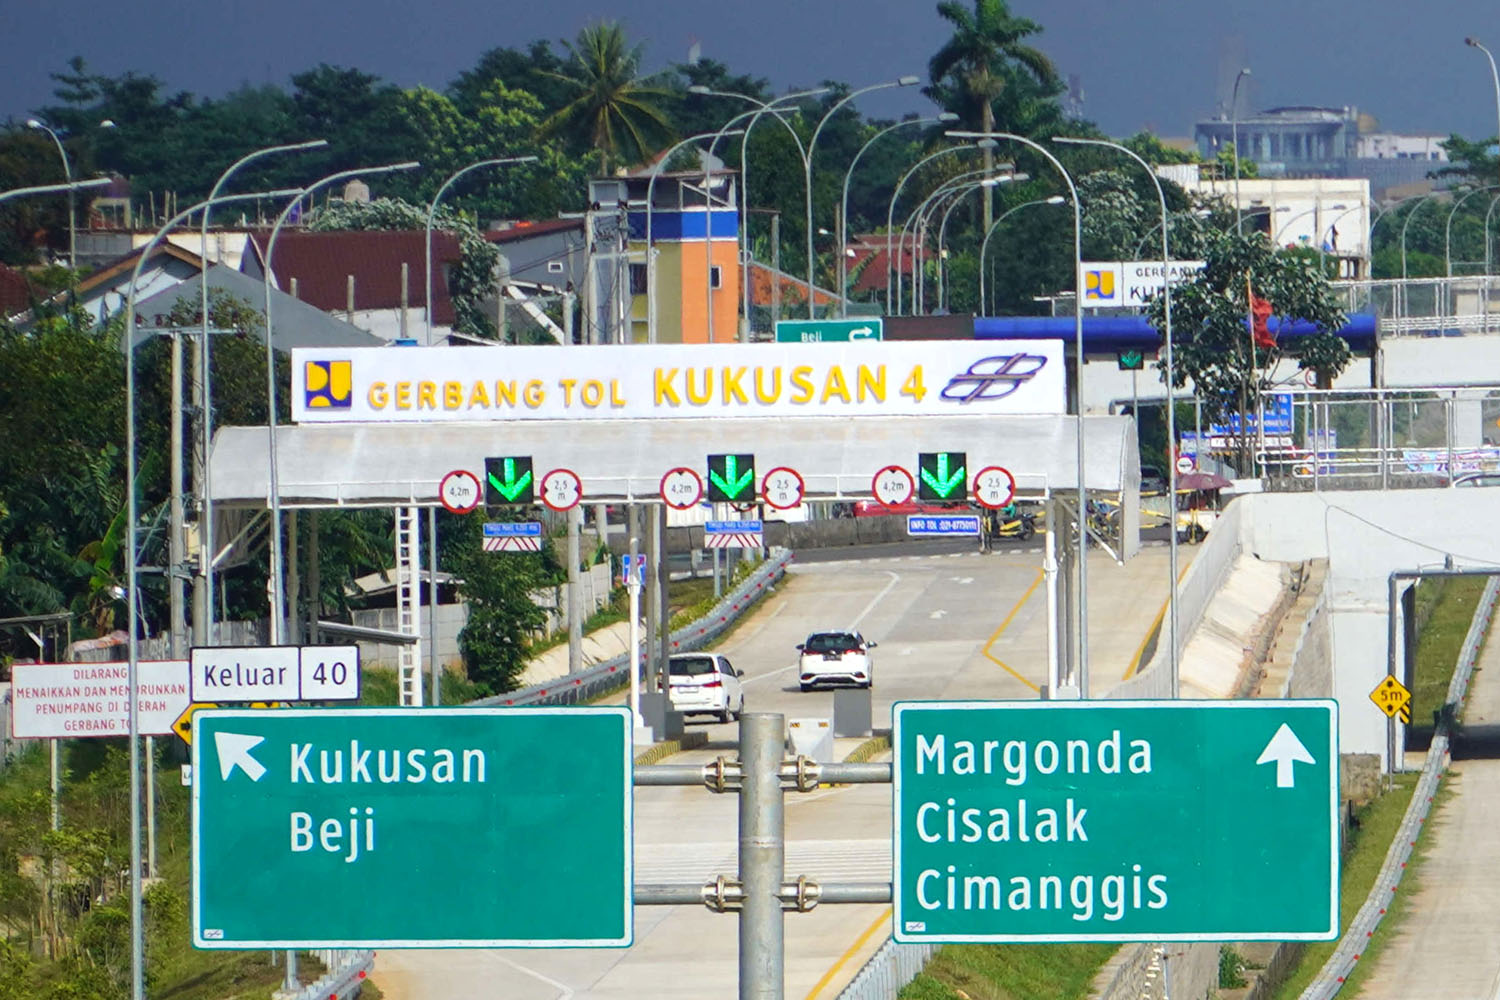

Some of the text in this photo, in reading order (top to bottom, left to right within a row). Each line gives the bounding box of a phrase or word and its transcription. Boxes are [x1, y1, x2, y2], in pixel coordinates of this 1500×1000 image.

[368, 364, 928, 409] GERBANG TOL KUKUSAN 4
[554, 480, 568, 490] 2,5
[671, 484, 693, 494] 4,2m
[776, 479, 789, 490] 2,5
[883, 482, 904, 492] 4,2m
[988, 478, 1000, 488] 2,5
[449, 487, 470, 497] 4,2m
[73, 668, 128, 680] DILARANG
[204, 661, 348, 688] Keluar 40
[16, 684, 186, 699] MENAIKKAN DAN MENRUNKAN
[36, 701, 167, 714] PENUMPANG DI DERAH
[64, 719, 115, 731] GERBANG
[290, 739, 487, 784] Kukusan
[915, 730, 1153, 786] Margonda
[915, 798, 1089, 843] Cisalak
[290, 806, 375, 863] Beji
[915, 864, 1169, 922] Cimanggis
